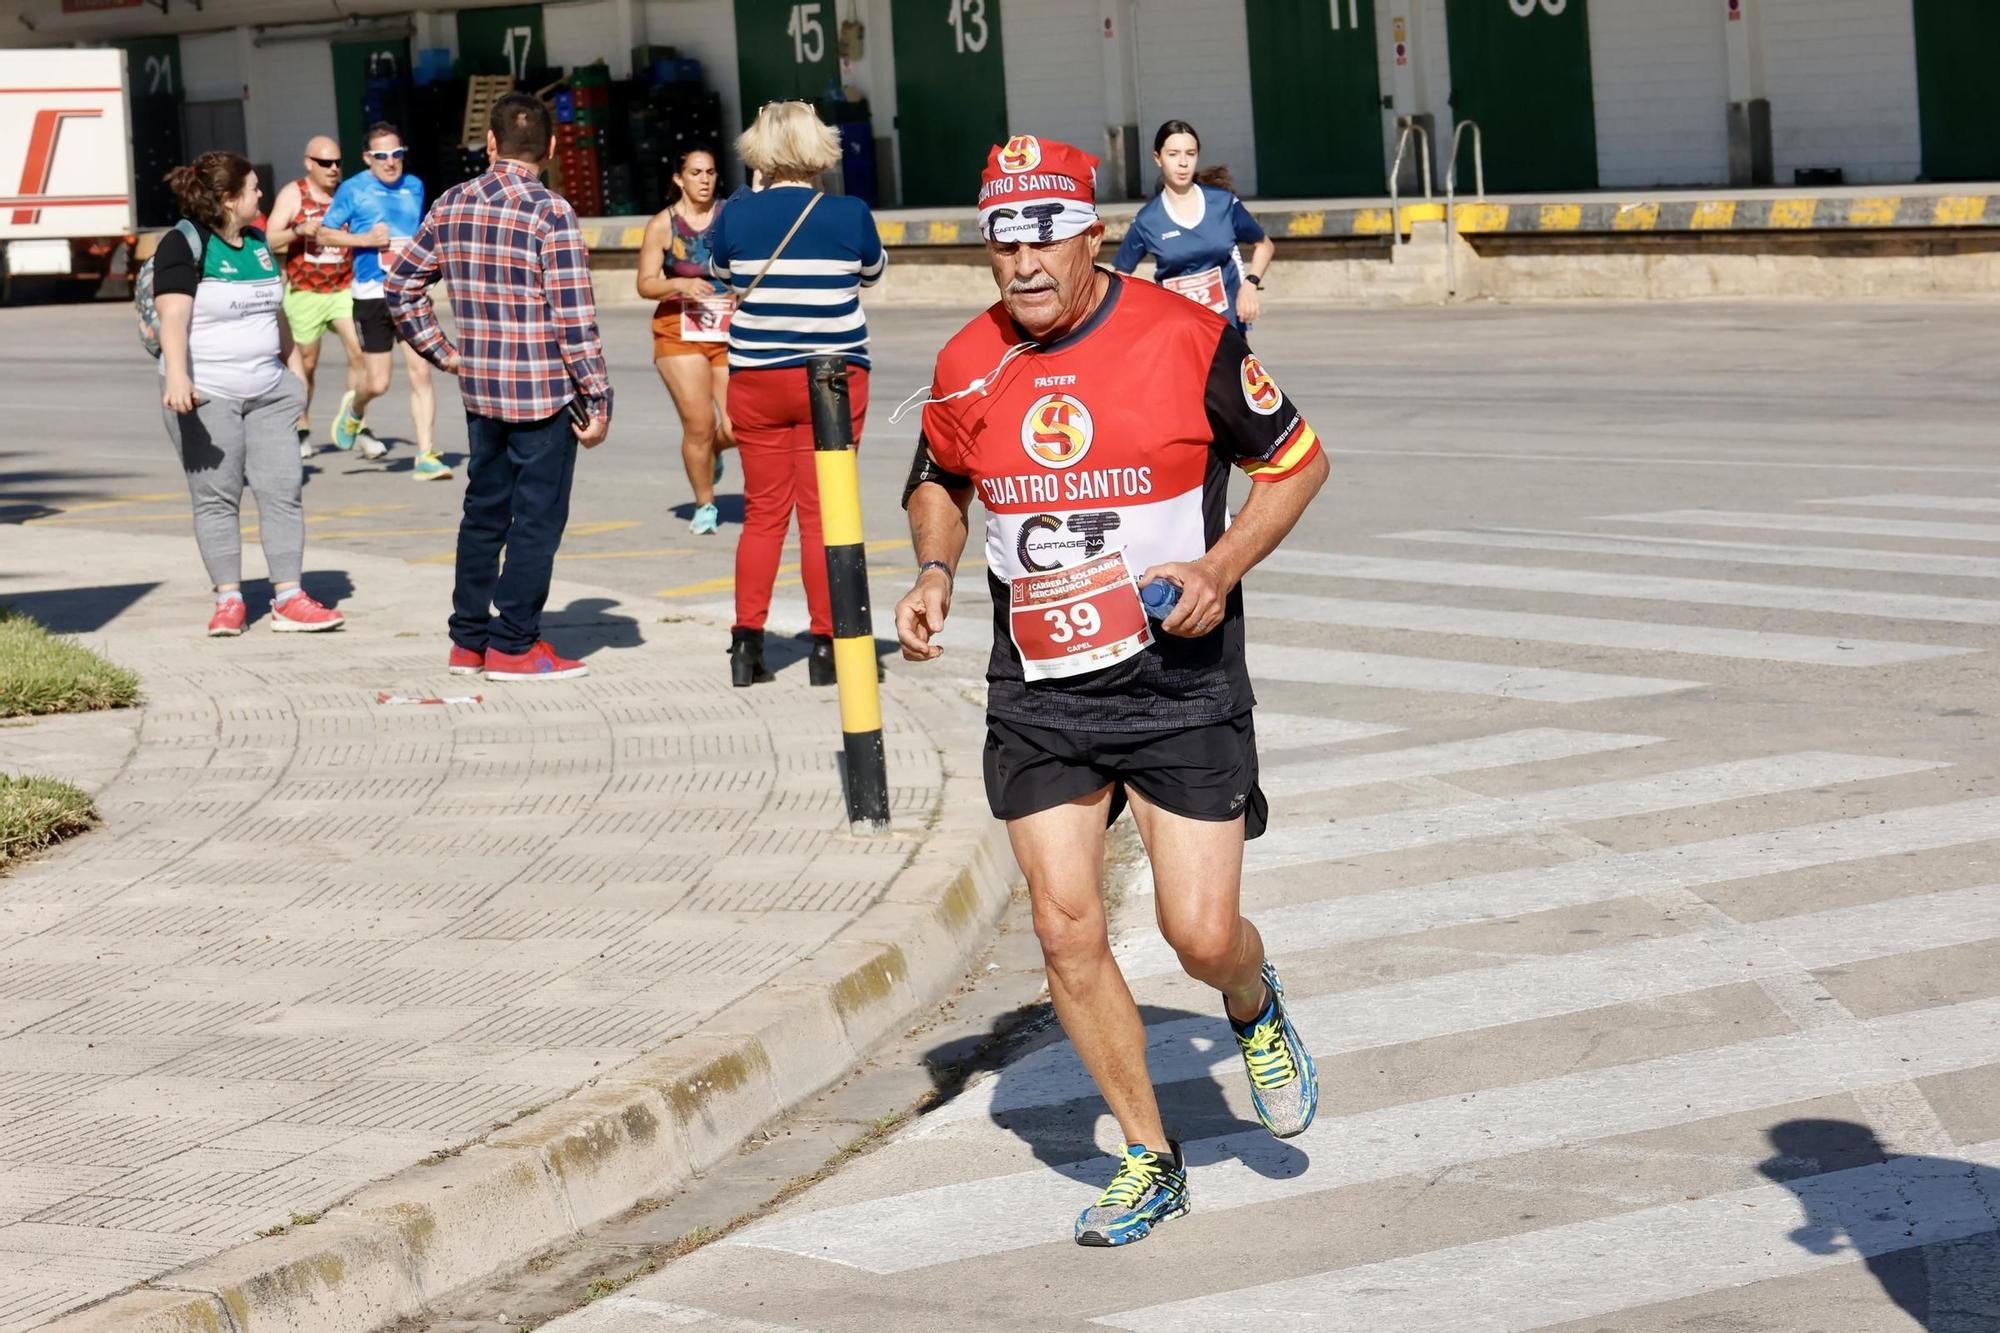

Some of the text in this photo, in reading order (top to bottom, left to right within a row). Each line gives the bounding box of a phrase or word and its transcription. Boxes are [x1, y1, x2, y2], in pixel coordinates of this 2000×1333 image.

[787, 3, 825, 64] 15
[948, 0, 988, 53] 13
[502, 26, 532, 81] 17
[145, 55, 173, 95] 21
[1018, 174, 1076, 192] SANTOS
[994, 221, 1054, 234] CARTAGENA
[1034, 375, 1076, 388] FASTER
[981, 466, 1152, 505] CUATRO SANTOS
[1028, 538, 1105, 551] CARTAGENA
[1029, 578, 1092, 599] MERCAMURCIA
[1031, 577, 1070, 591] CARRERA
[1069, 559, 1121, 581] SOLIDARIA
[1044, 602, 1102, 643] 39
[1067, 641, 1093, 653] CAPEL
